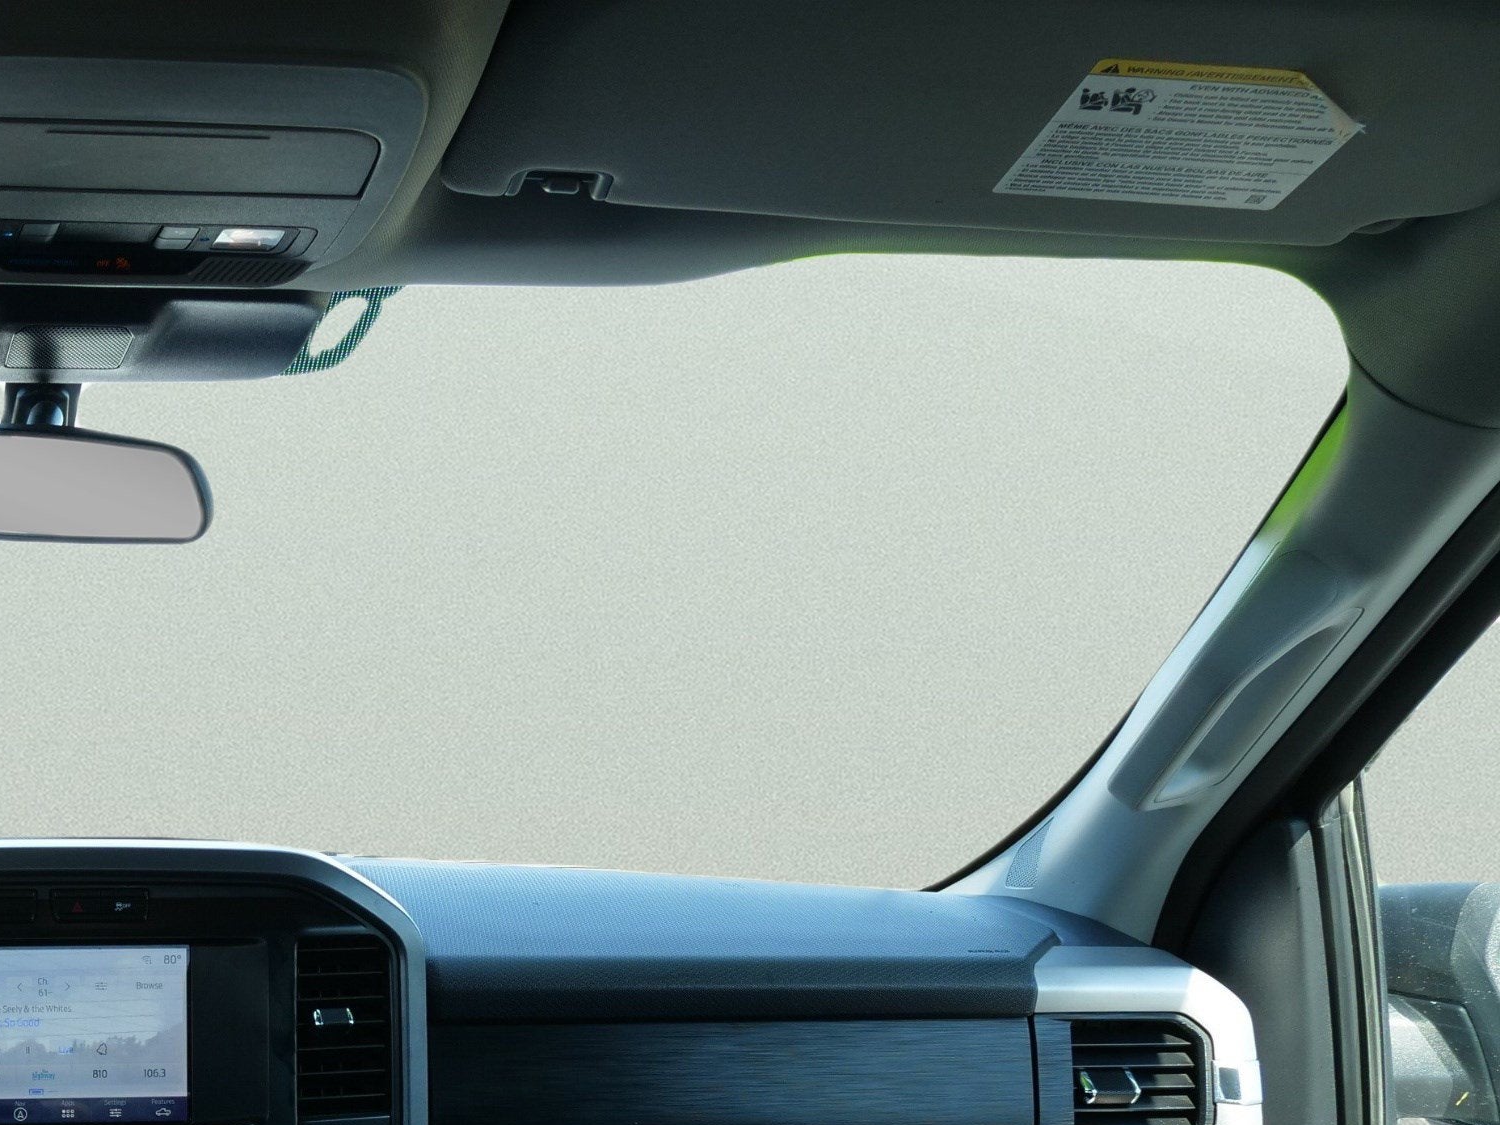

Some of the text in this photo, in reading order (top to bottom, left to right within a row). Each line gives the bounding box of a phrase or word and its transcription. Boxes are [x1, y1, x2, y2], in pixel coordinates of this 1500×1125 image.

[1126, 66, 1186, 76] WARNING
[163, 954, 182, 964] 80°
[37, 978, 48, 986] Ch
[2, 1005, 22, 1014] Seely
[24, 1005, 30, 1014] &
[31, 1005, 44, 1013] the
[46, 1005, 72, 1013] Whites
[92, 1069, 108, 1078] 810
[144, 1068, 166, 1078] 106.3
